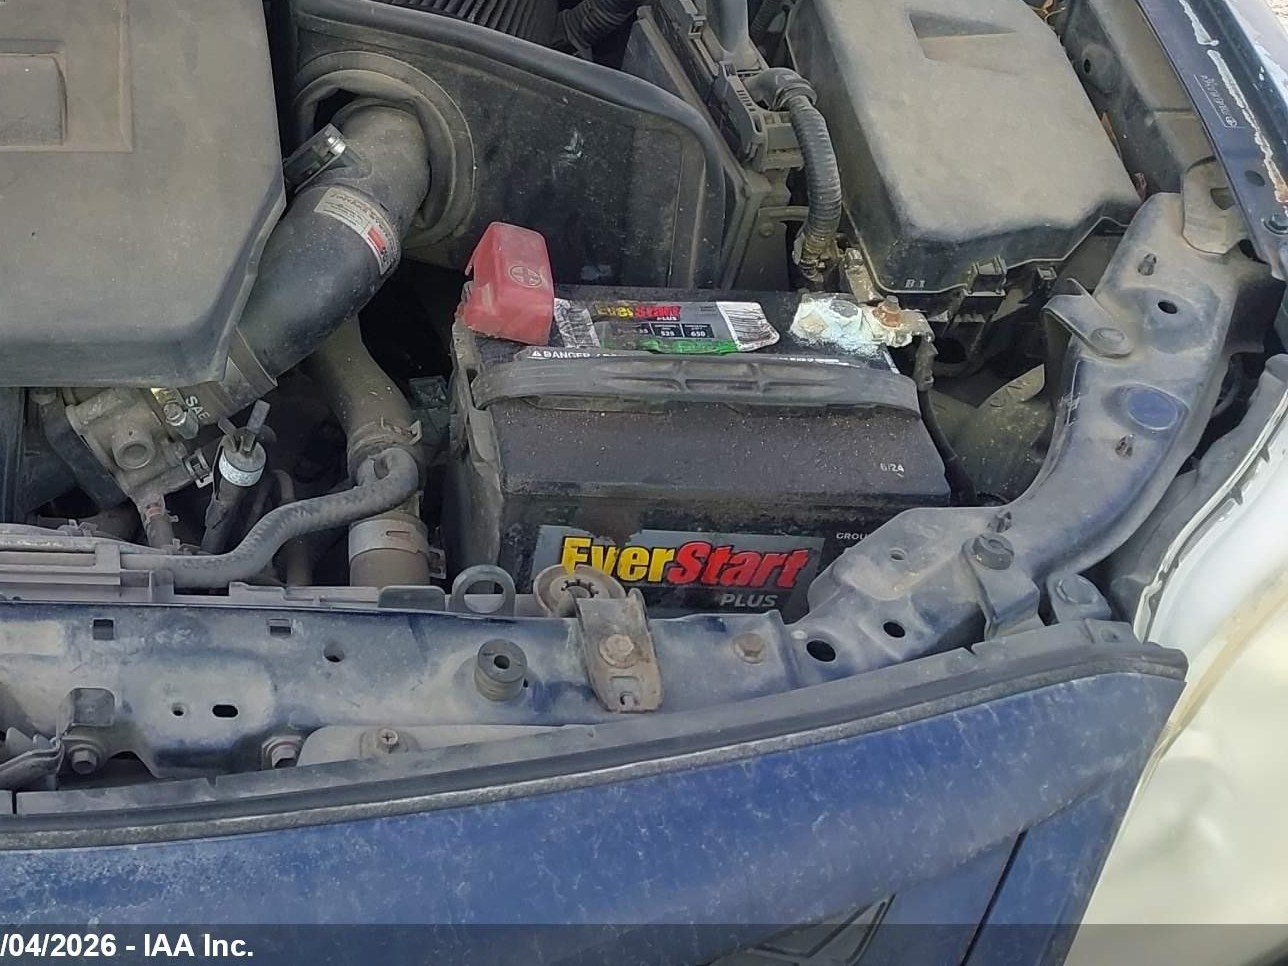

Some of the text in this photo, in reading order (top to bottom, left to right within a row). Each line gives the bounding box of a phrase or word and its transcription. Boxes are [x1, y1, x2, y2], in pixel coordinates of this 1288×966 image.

[185, 395, 210, 420] SAE
[835, 532, 872, 541] GROU
[562, 535, 810, 588] EverStart
[719, 593, 779, 609] PLUS
